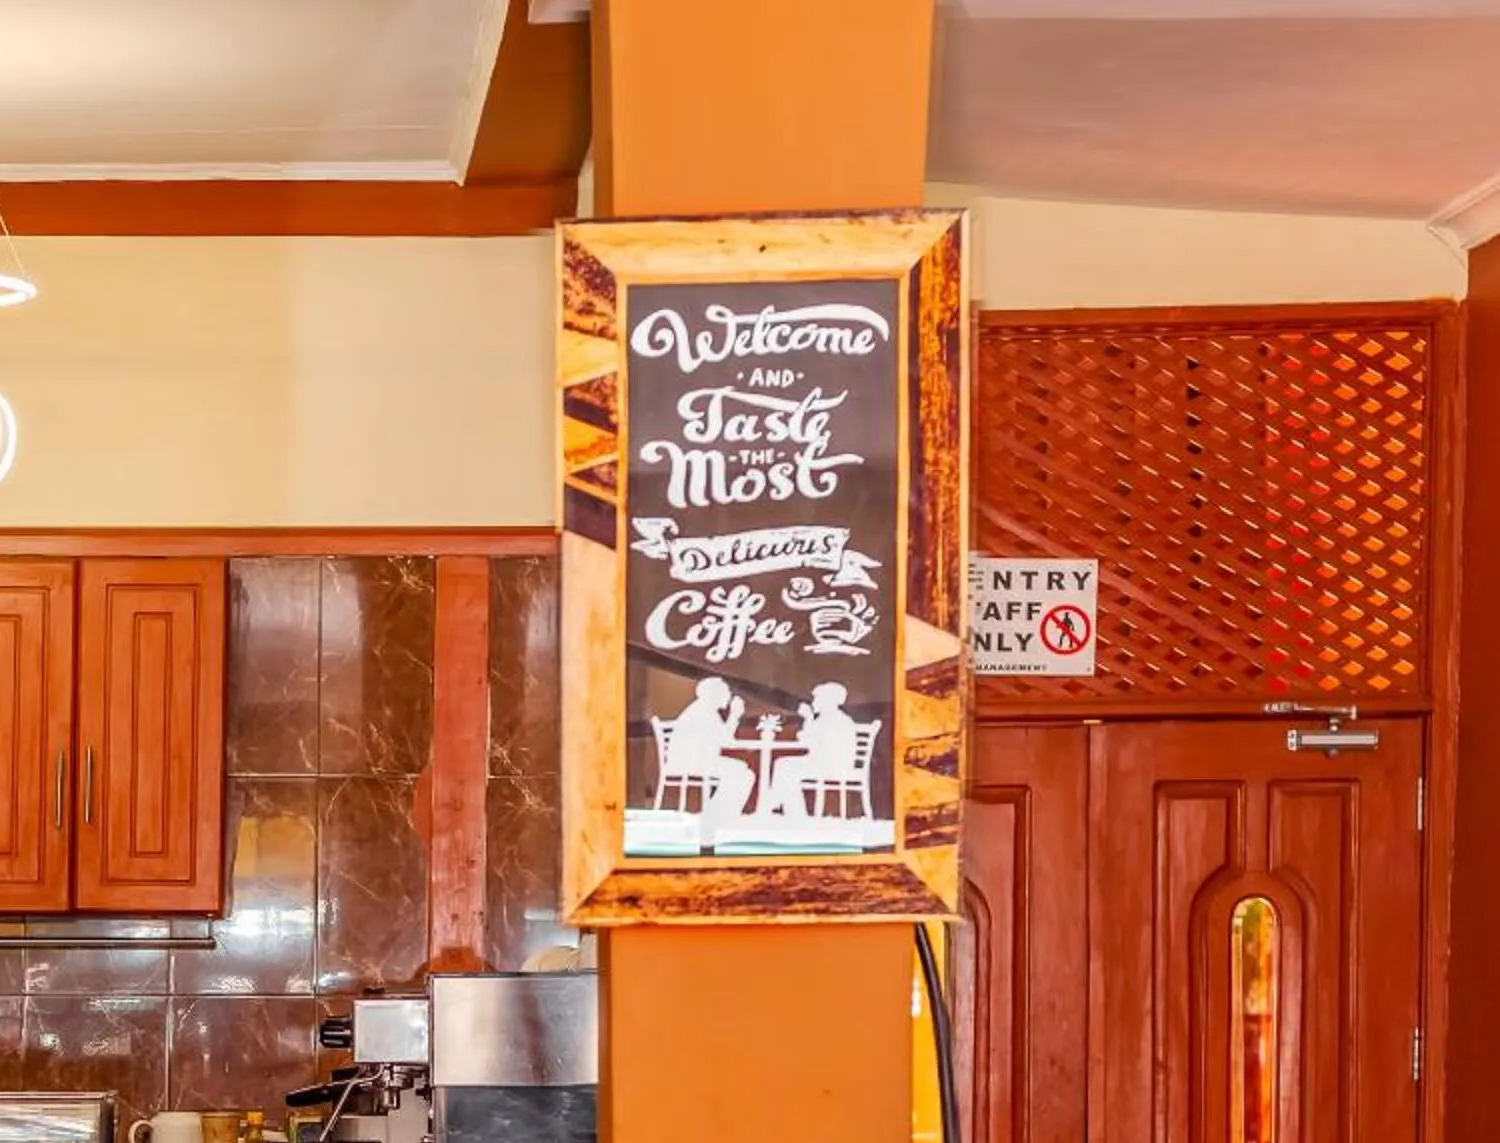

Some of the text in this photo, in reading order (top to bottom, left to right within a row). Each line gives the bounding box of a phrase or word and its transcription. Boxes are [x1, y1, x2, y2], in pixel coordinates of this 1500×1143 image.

[631, 304, 889, 372] Welcome
[749, 368, 794, 387] AND
[677, 386, 848, 444] Taste
[640, 440, 864, 508] Most
[739, 449, 776, 465] THE
[645, 584, 796, 662] Coffee
[975, 601, 1043, 621] AFF
[974, 632, 1034, 652] NLY
